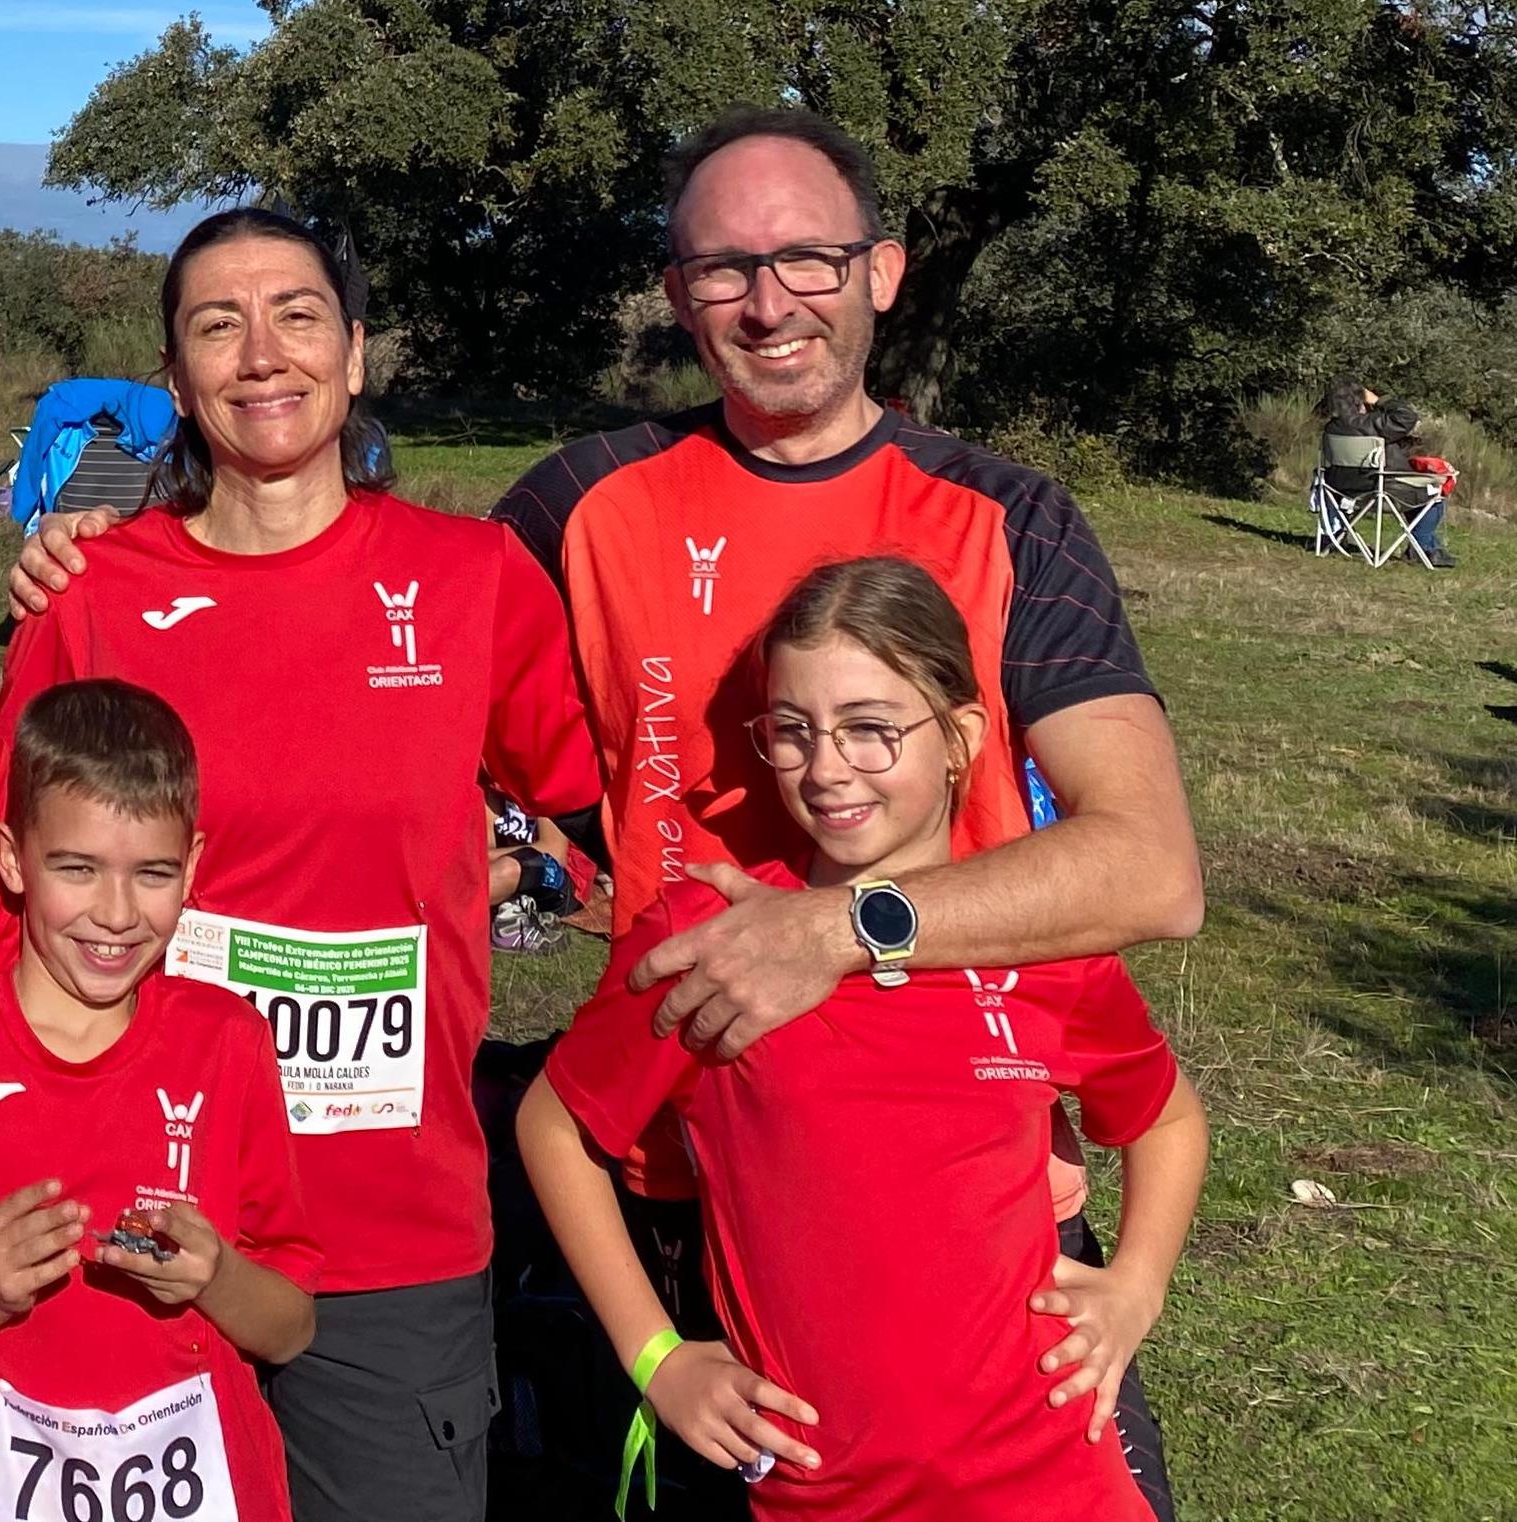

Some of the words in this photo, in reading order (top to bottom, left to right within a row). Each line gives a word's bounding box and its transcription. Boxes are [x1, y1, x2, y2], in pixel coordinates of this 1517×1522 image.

[385, 609, 414, 621] CAX
[369, 671, 443, 688] ORIENTACIÓ
[337, 1066, 371, 1079] CALDES
[165, 1122, 193, 1139] CAX
[135, 1197, 171, 1211] ORIE
[137, 1392, 203, 1426] Orientación
[10, 1436, 204, 1522] 7668
